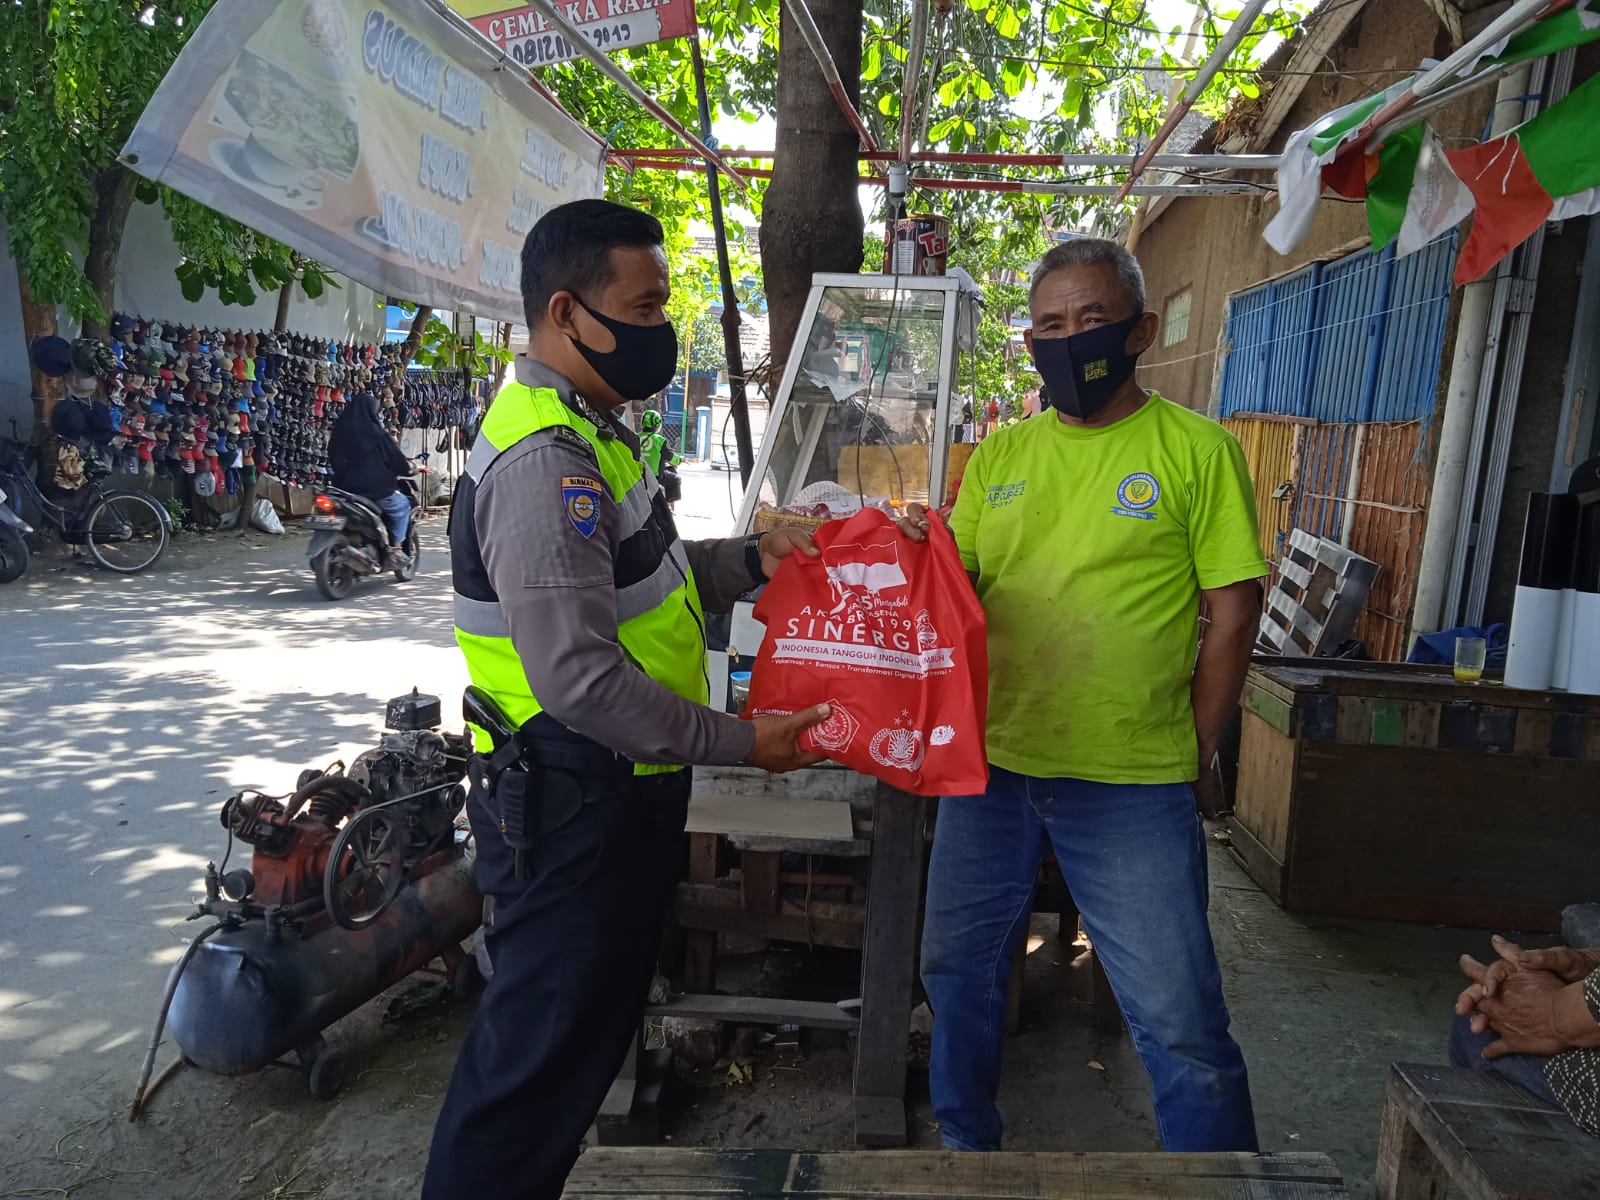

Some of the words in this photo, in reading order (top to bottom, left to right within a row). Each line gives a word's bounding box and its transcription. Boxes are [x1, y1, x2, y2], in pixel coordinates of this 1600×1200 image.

[488, 0, 601, 42] CEMPKA
[781, 643, 829, 655] INDONESIA
[831, 648, 877, 660] TANGGUH
[879, 654, 922, 668] INDONESIA
[847, 664, 893, 676] Transformasi
[894, 670, 915, 679] Digital
